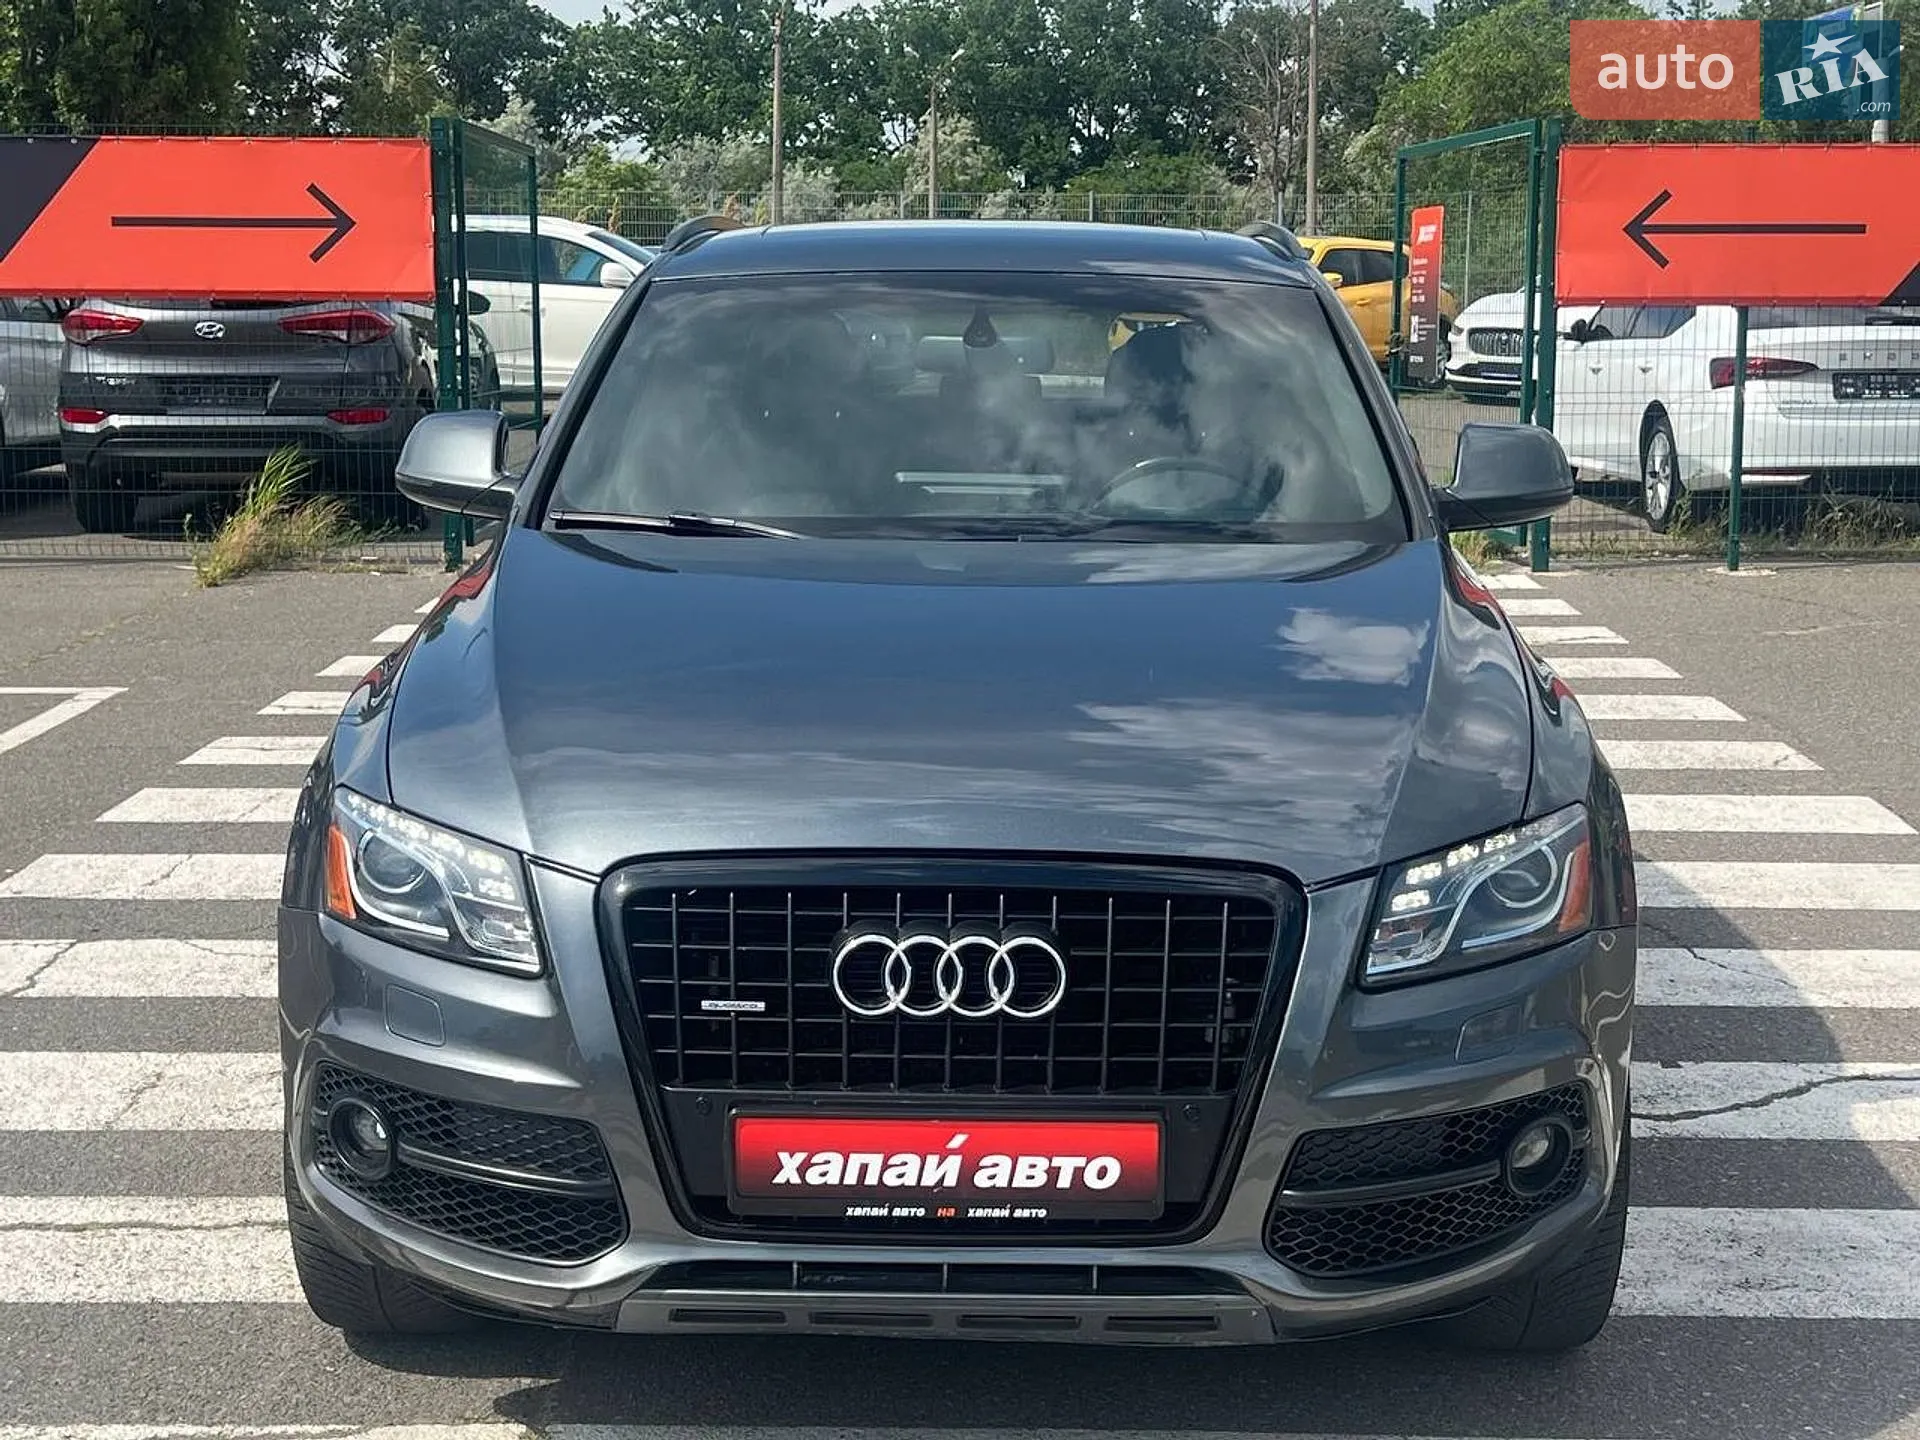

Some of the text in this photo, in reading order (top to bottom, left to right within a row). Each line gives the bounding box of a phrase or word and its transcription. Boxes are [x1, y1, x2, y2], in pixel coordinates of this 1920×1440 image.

[973, 1153, 1121, 1189] авто
[892, 1206, 925, 1217] авто
[937, 1208, 956, 1217] на
[1013, 1208, 1047, 1218] авто
